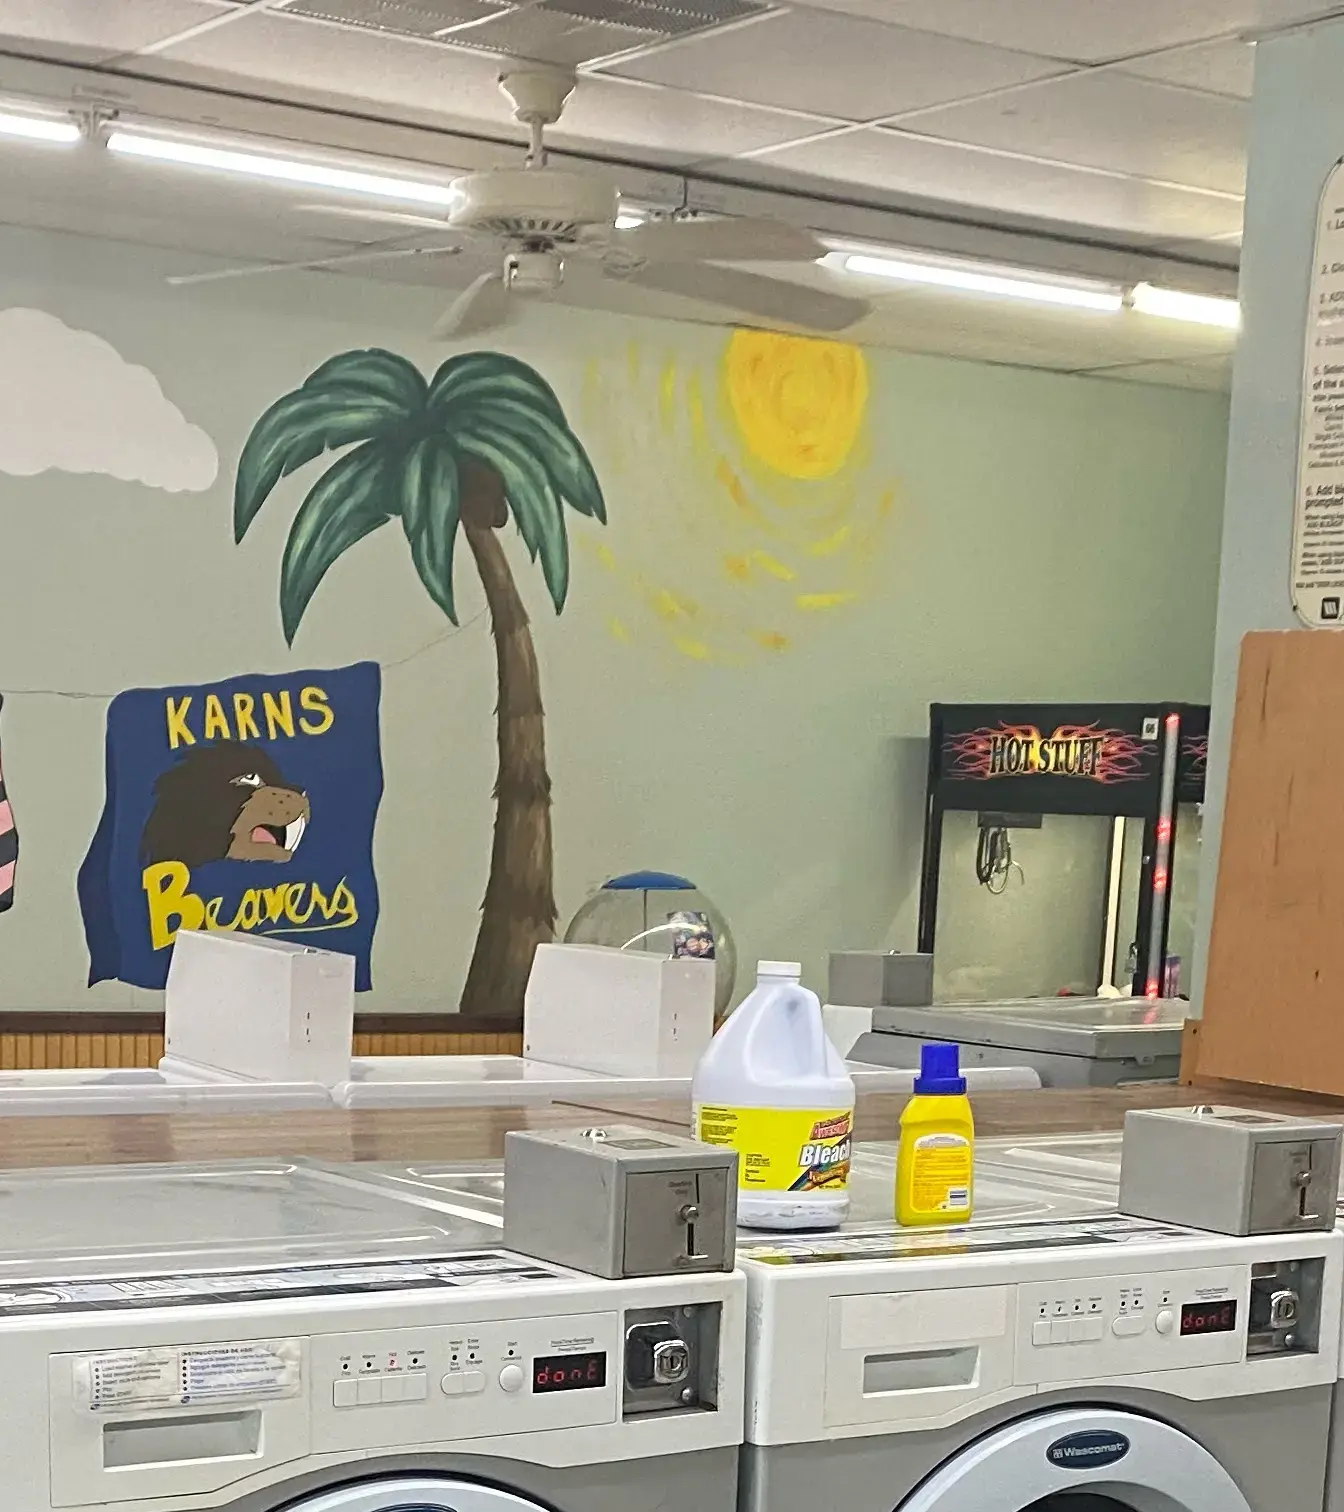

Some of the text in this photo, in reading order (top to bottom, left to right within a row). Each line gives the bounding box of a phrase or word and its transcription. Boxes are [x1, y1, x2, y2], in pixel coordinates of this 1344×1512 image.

[164, 686, 336, 750] KARNS
[989, 735, 1106, 777] HOT STUFF
[141, 860, 359, 951] Beavers
[1063, 1443, 1124, 1457] Wascomat
